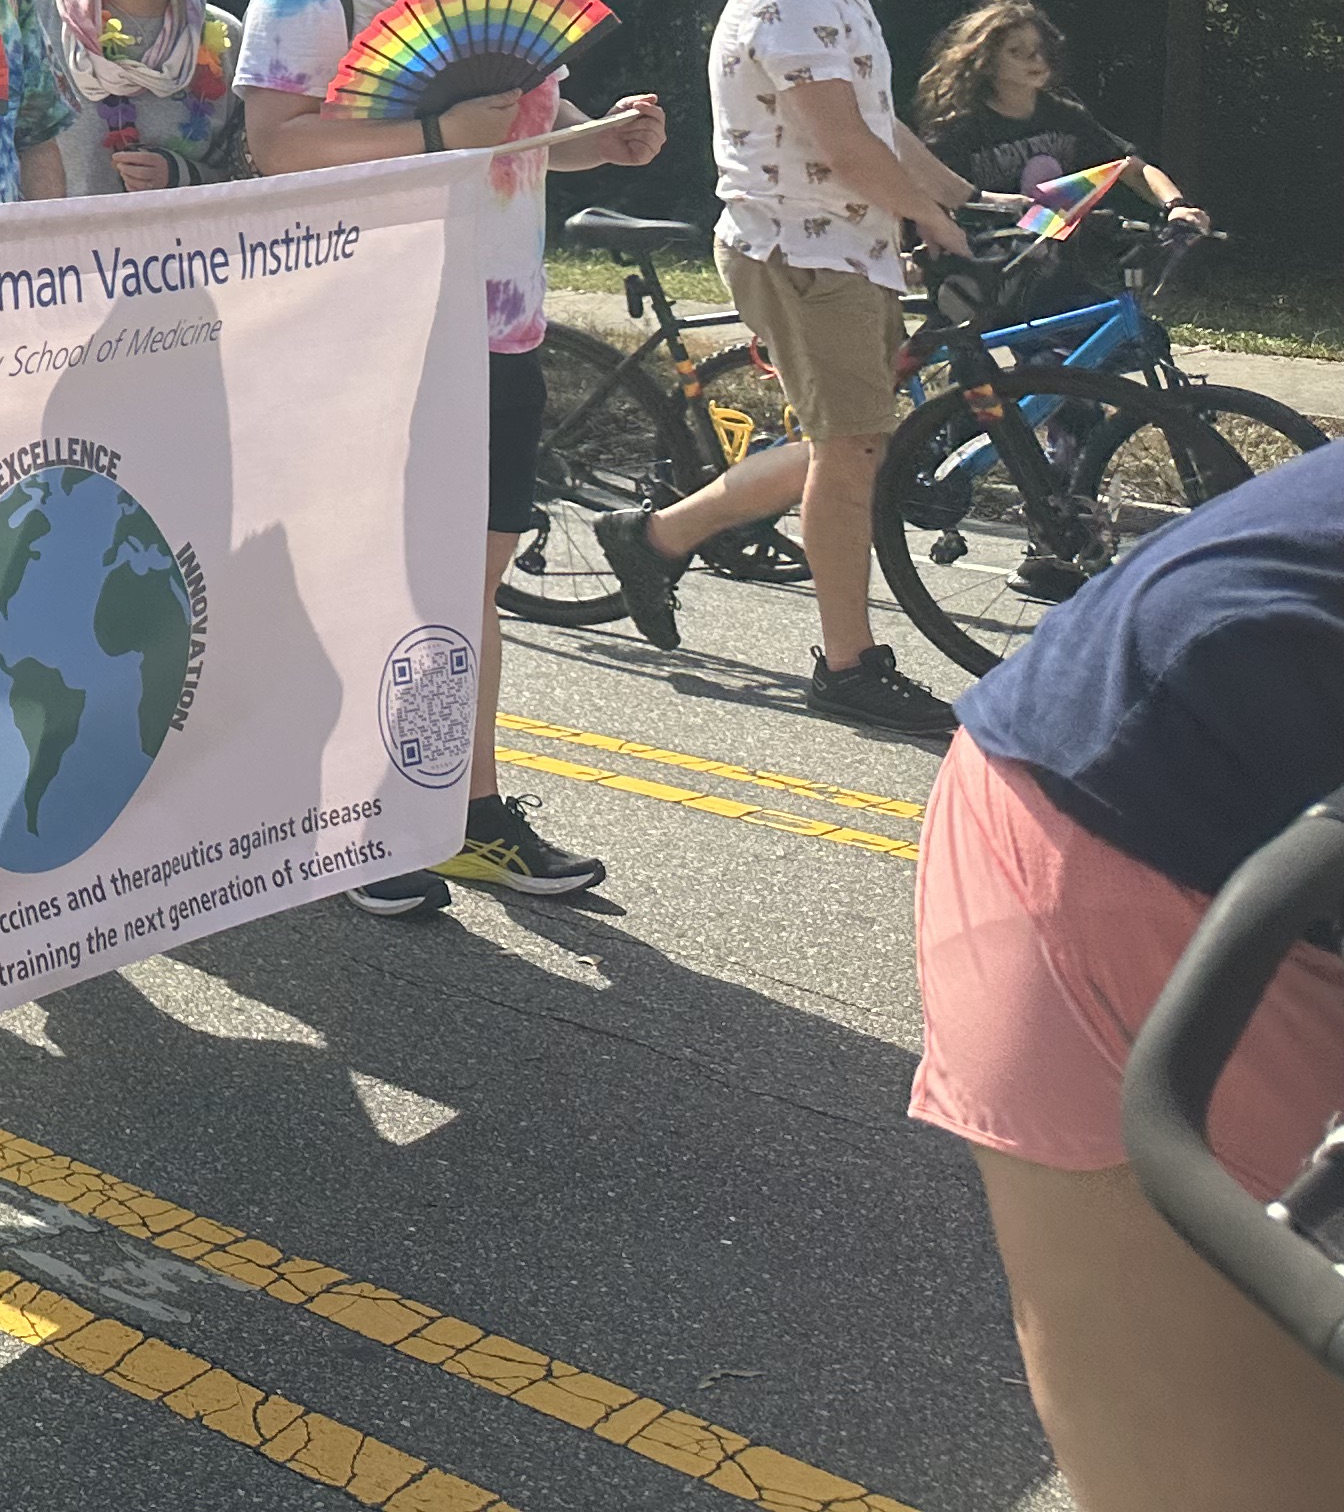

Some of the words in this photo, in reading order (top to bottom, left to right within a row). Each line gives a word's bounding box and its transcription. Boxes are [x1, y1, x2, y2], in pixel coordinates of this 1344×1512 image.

[92, 238, 229, 300] Vaccine
[238, 220, 360, 280] Institute
[8, 331, 95, 377] School
[96, 328, 125, 363] of
[126, 316, 223, 358] Medicine
[169, 542, 209, 732] INNOVATION
[68, 875, 107, 911] and
[110, 840, 223, 896] therapeutics
[229, 816, 296, 859] against
[301, 795, 383, 835] diseases
[86, 924, 118, 956] the
[124, 906, 166, 944] next
[169, 874, 268, 931] generation
[271, 859, 295, 888] of
[299, 838, 393, 881] scientists.
